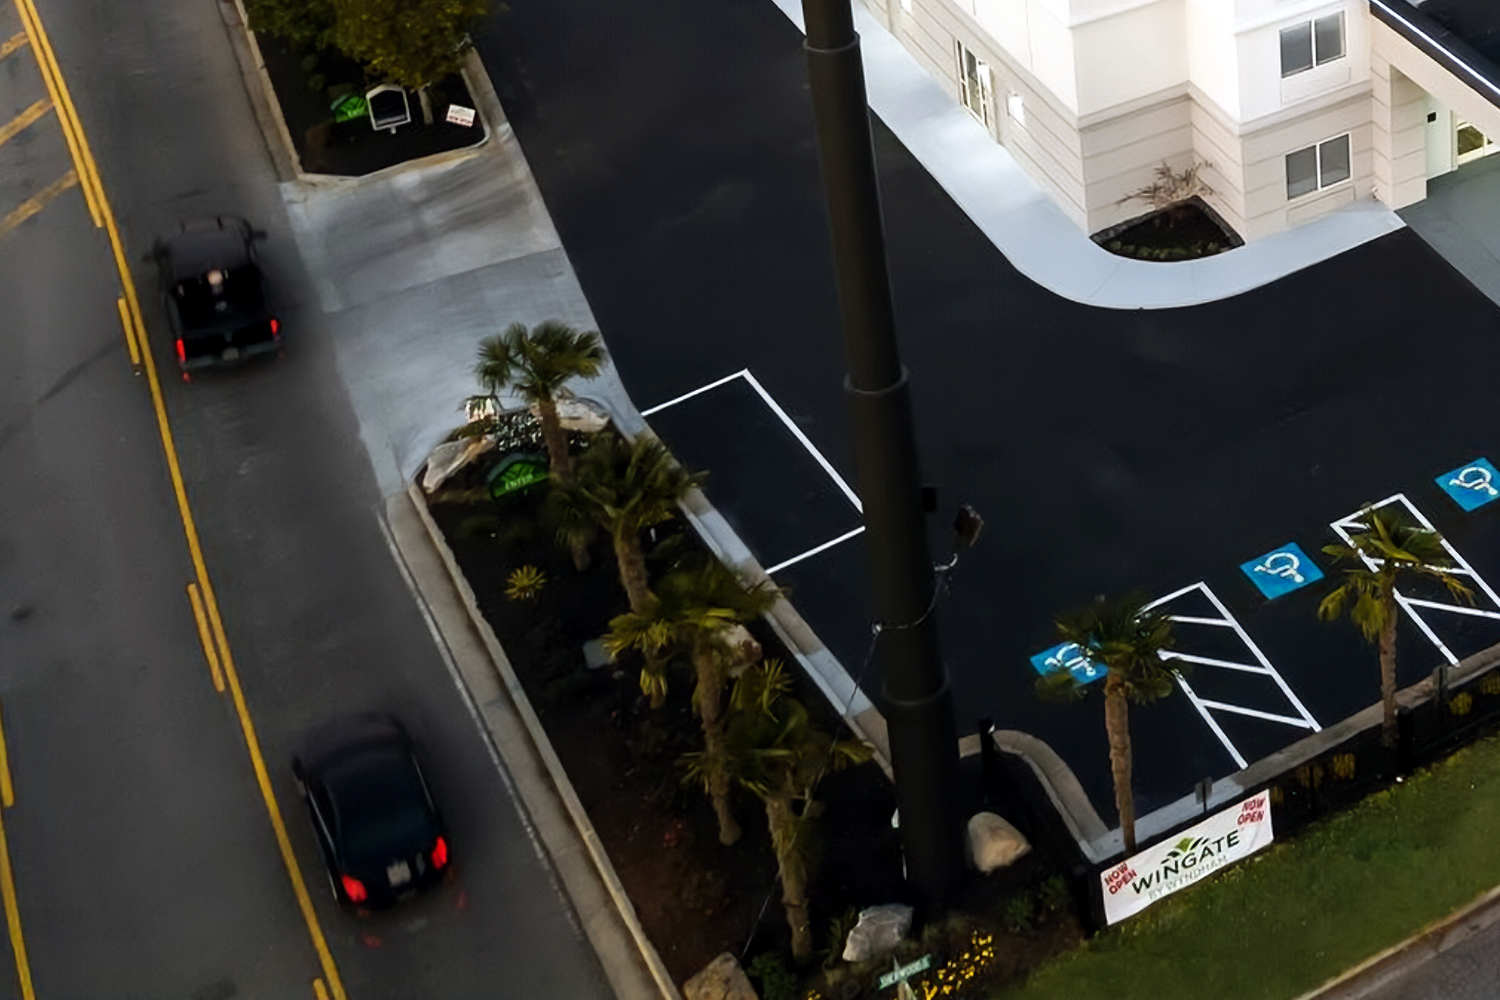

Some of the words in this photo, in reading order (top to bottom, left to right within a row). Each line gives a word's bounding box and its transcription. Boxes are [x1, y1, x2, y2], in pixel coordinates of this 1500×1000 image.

[1241, 798, 1265, 812] NOW
[1237, 810, 1265, 826] OPEN
[1132, 829, 1240, 895] WINGATE
[1104, 863, 1128, 885] NOW
[1108, 869, 1137, 896] OPEN
